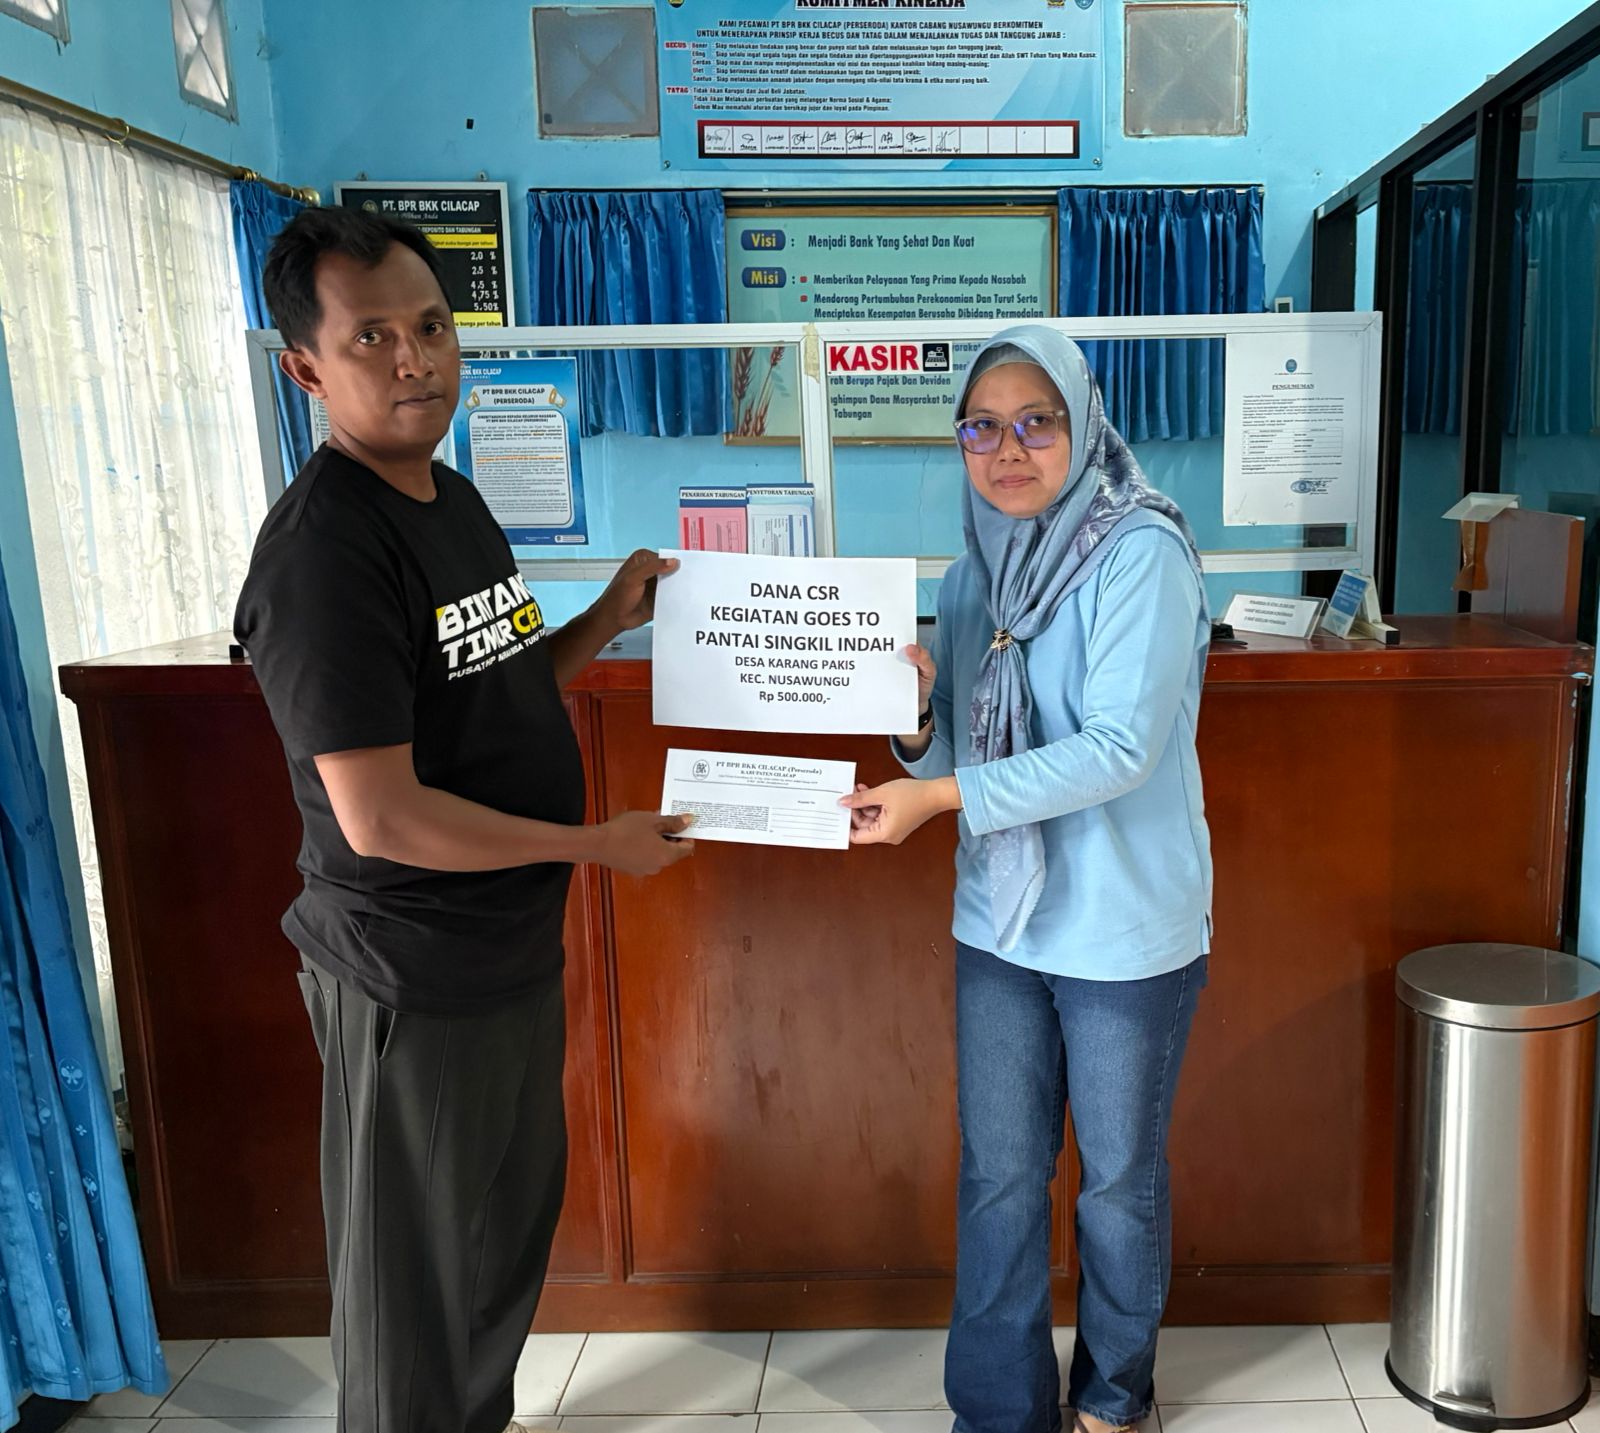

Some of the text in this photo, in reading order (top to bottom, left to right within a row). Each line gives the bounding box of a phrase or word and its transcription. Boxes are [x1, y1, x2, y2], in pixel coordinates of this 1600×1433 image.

[719, 20, 1043, 30] KAMI PEGAWAI PT BPR BKK CILACAP (PERSERODA) KANTOR CABANG NUSAWUNGU BERKOMITMEN
[697, 30, 1061, 40] UNTUK MENERAPKAN PRINSIP KERJA BECUS DAN TATAG DALAM MENJALANKAN TUGAS DAN TANGGUNG JAWAB
[382, 200, 480, 212] PT. BPR BKK CILACAP
[751, 233, 777, 248] Visi
[808, 235, 975, 251] Menjadi Bank Yang Sehat Dan Kuat
[490, 252, 496, 261] %
[491, 266, 498, 275] %
[751, 271, 779, 285] Misi
[813, 274, 1026, 287] Memberikan Pelayanan Yang Prima Kepada Nasabah
[491, 280, 498, 290] %
[814, 294, 1038, 306] Mendorong Pertumbuhan Perekonomian Dan Turut Serta
[814, 308, 1044, 320] Menciptakan Kesempatan Berusaha Dibidang Permodalan
[830, 344, 919, 372] KASIR
[846, 376, 875, 388] Berupa
[876, 376, 900, 388] Pajak
[902, 376, 917, 386] Dan
[920, 375, 951, 386] Deviden
[482, 388, 545, 397] PT BPR BKK CILACAP
[494, 397, 535, 406] (PERSERODA)
[870, 394, 890, 405] Dana
[892, 394, 940, 407] Masyarakat
[834, 409, 872, 421] Tabungan
[750, 582, 840, 601] DANA CSR
[710, 606, 880, 626] KEGIATAN GOES TO
[696, 630, 895, 652] PANTAI SINGKIL INDAH
[735, 656, 856, 670] DESA KARANG PAKIS
[740, 673, 850, 687] KEC. NUSAWUNGU
[760, 691, 831, 705] Rp 500.000,-
[758, 764, 787, 772] CILACAP
